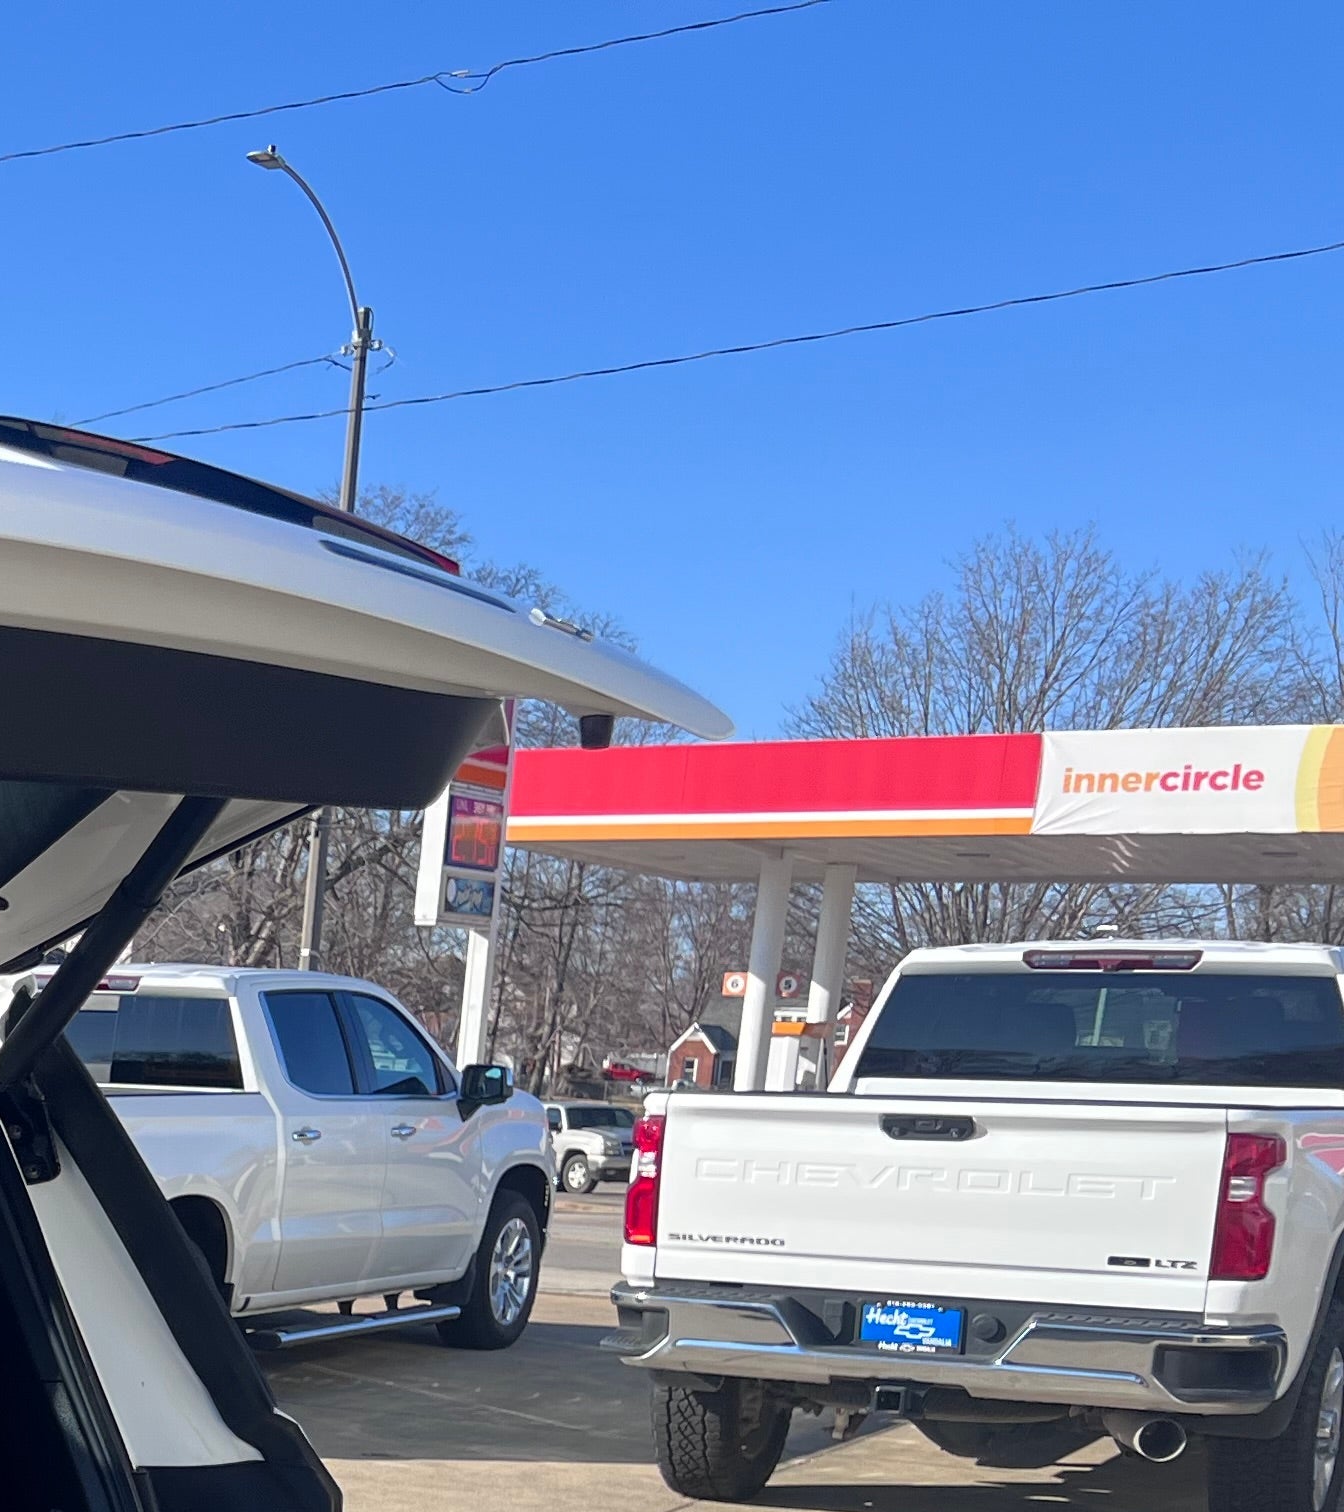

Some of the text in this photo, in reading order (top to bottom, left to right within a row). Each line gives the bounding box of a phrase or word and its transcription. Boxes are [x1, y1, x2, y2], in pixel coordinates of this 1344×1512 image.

[1063, 764, 1265, 793] innercircle
[695, 1157, 1177, 1201] CHEVROLET
[668, 1233, 785, 1246] SILVERADO
[1154, 1259, 1197, 1270] LTZ
[865, 1307, 909, 1326] Hecht
